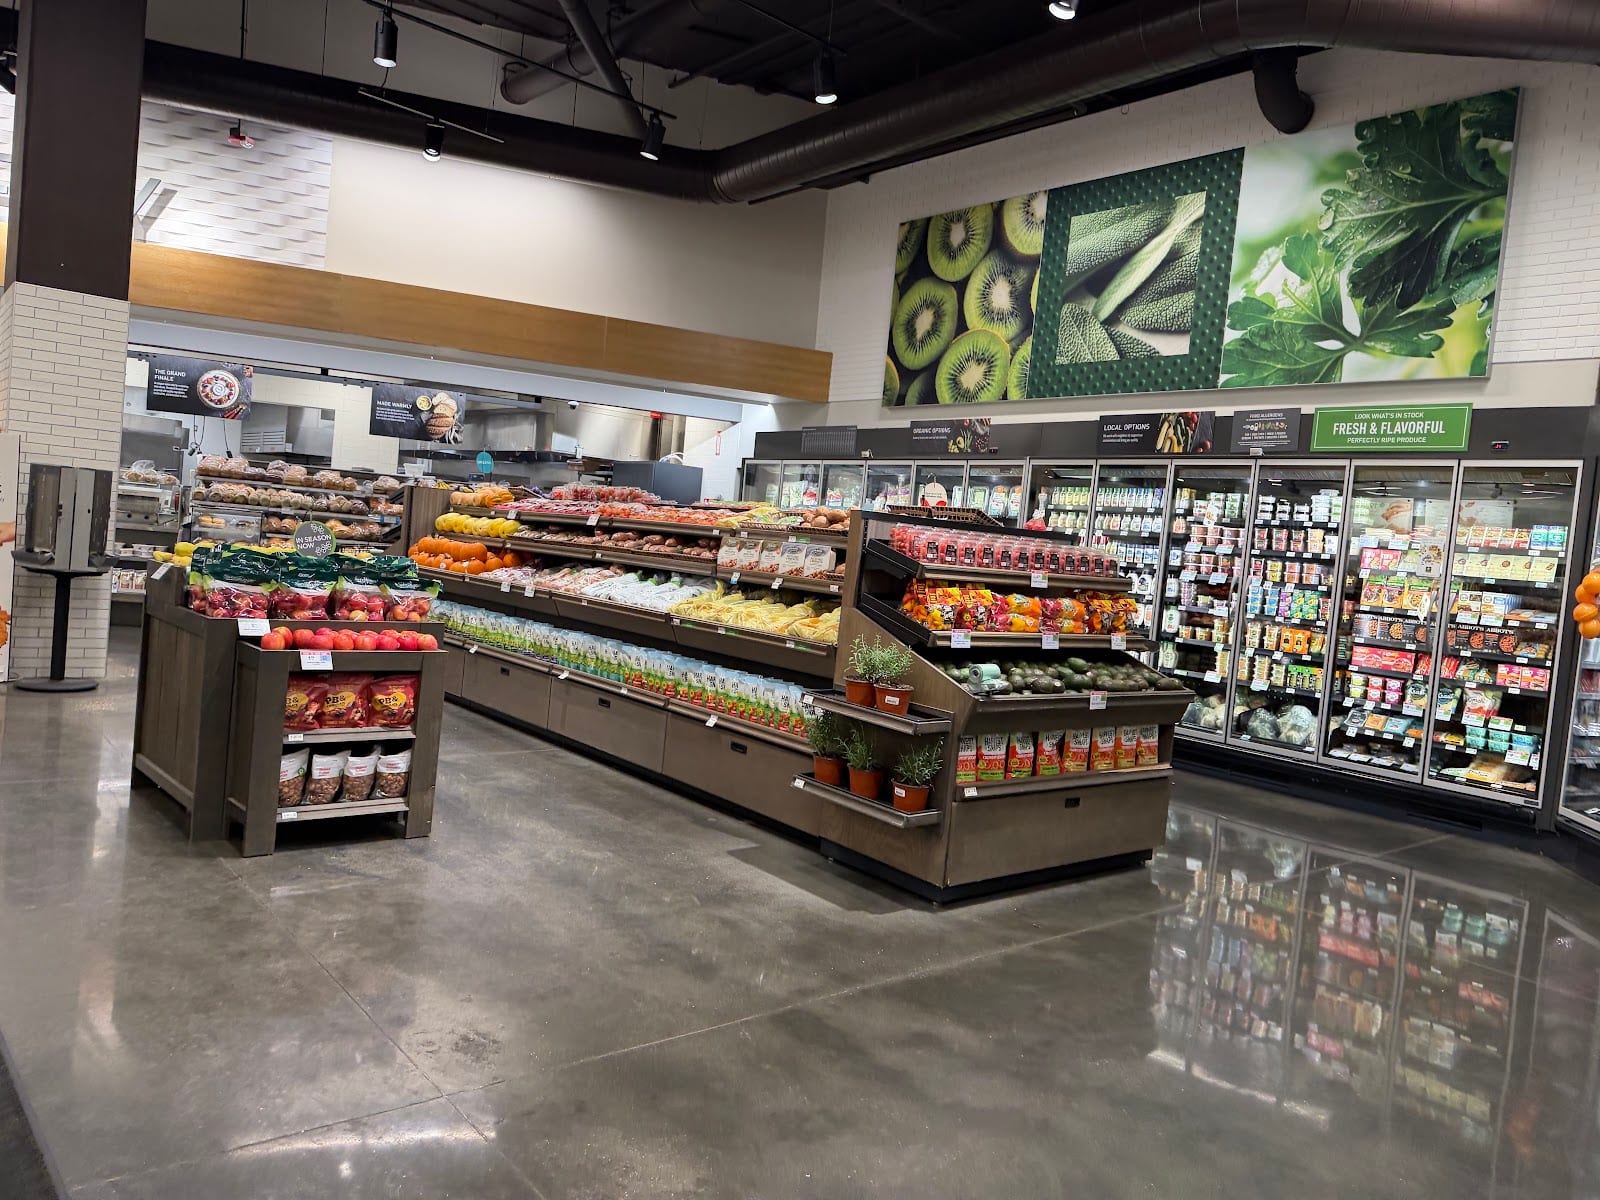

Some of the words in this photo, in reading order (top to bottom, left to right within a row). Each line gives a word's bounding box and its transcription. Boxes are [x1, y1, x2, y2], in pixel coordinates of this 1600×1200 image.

[1123, 423, 1151, 431] OPTIONS
[1333, 422, 1367, 435] FRESH
[1369, 421, 1378, 435] &
[1380, 420, 1446, 435] FLAVORFUL
[304, 534, 332, 543] SEASON
[297, 542, 315, 550] NOW
